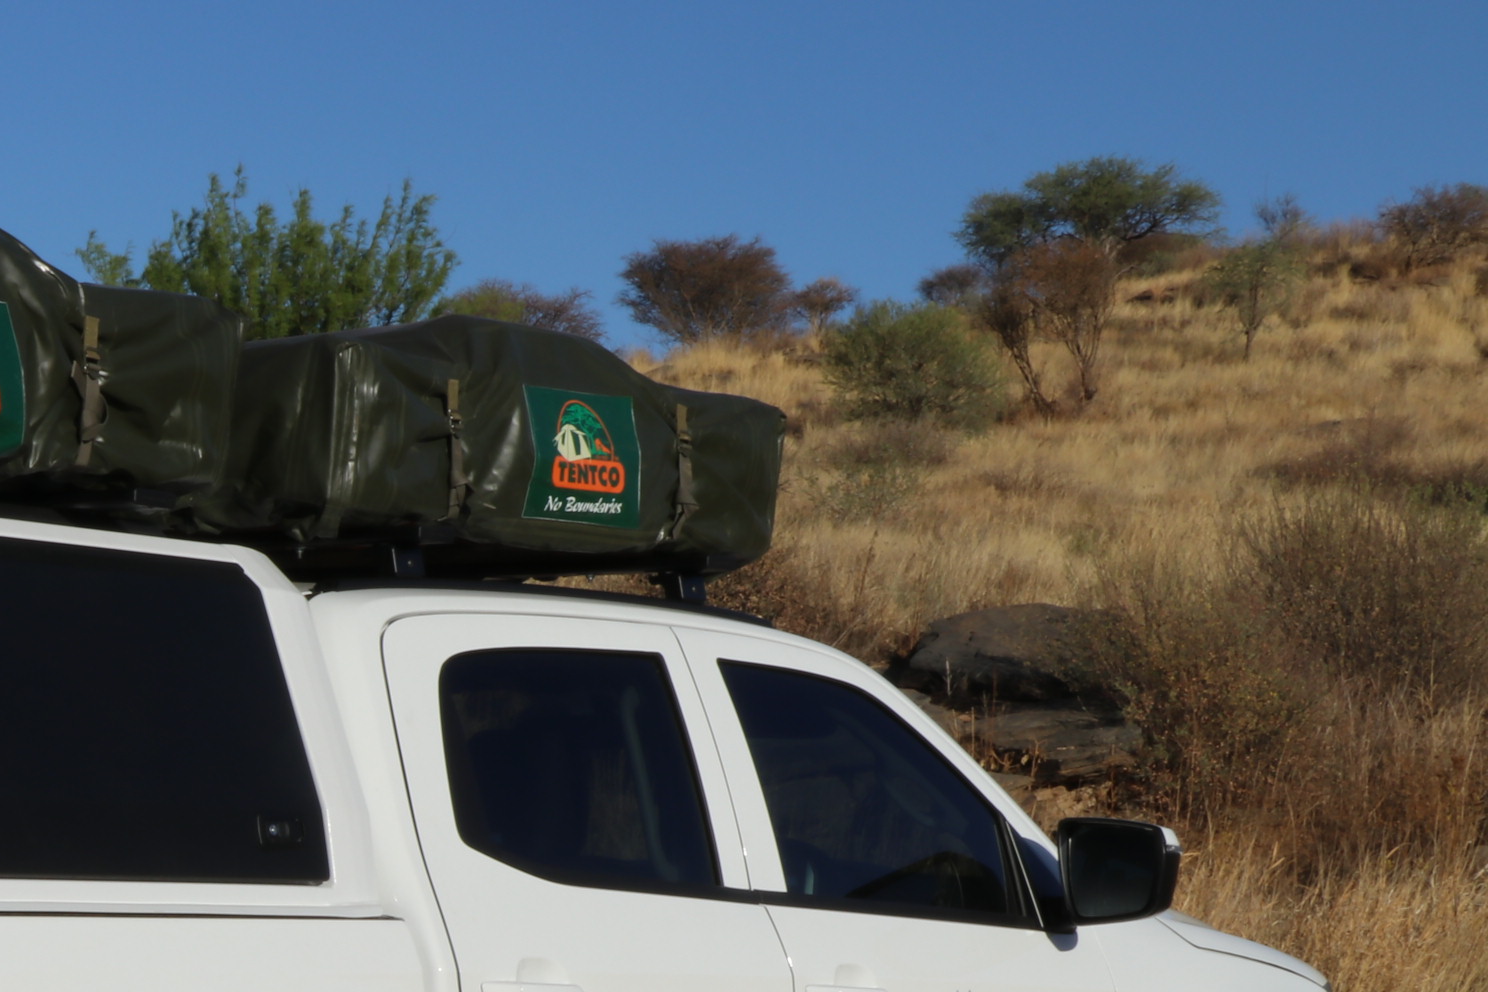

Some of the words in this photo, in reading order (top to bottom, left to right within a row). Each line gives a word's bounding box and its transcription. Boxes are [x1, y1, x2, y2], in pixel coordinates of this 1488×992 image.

[558, 461, 620, 488] TENTCO
[544, 495, 562, 512] No
[564, 496, 623, 514] Boundaries
